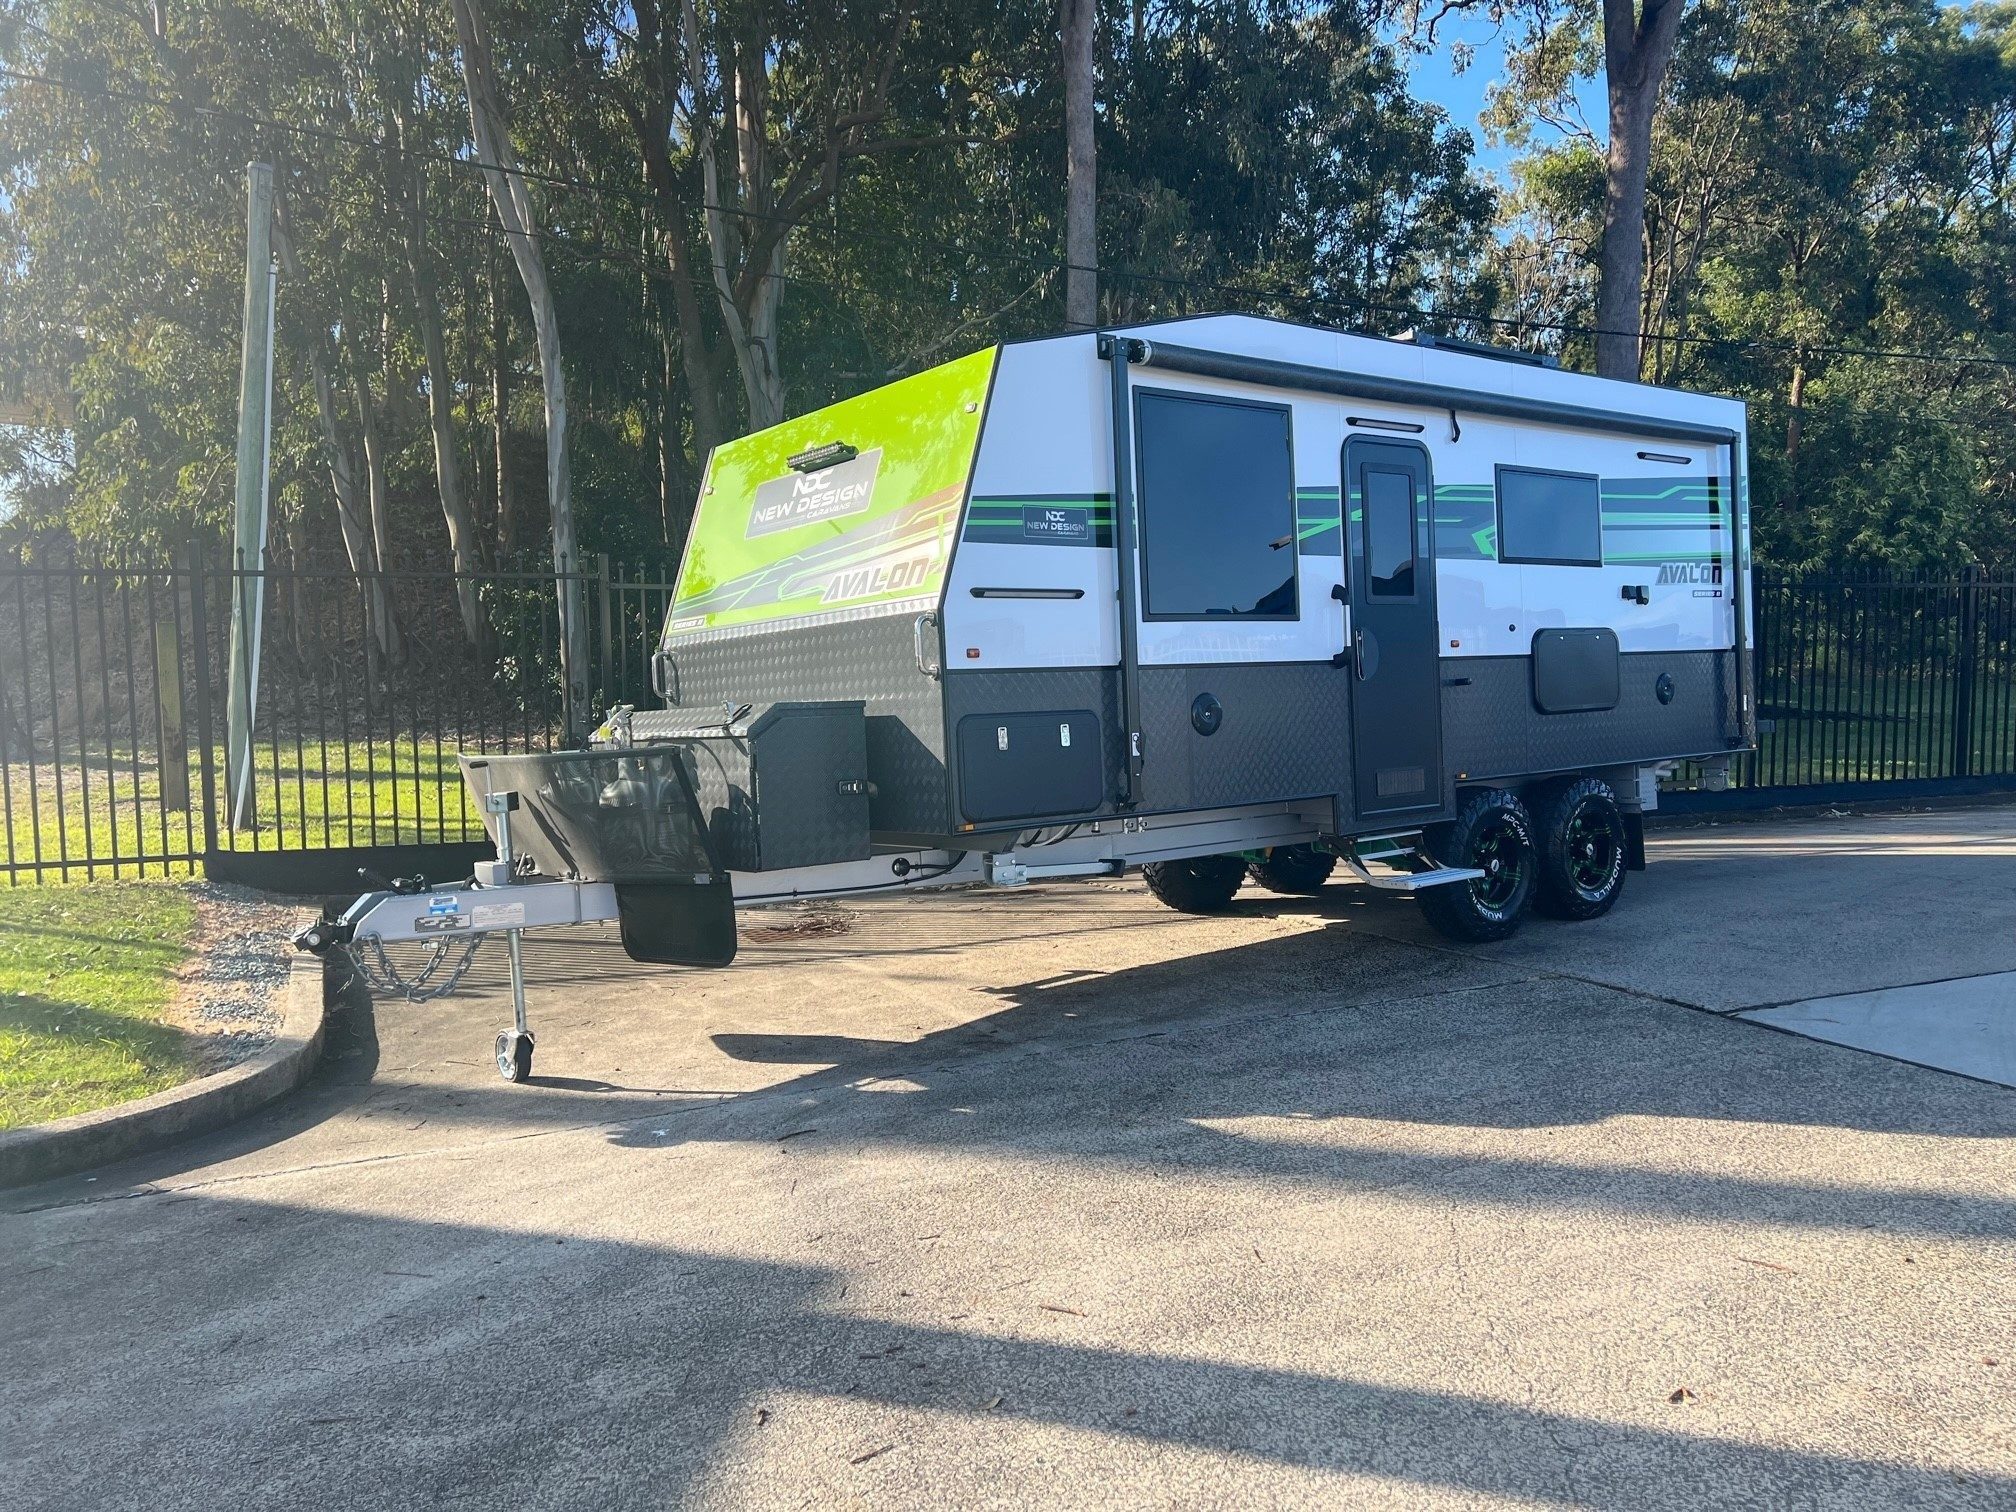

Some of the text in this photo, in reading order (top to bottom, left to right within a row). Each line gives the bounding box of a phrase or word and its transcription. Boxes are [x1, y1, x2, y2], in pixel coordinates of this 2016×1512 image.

[792, 468, 834, 498] NDC
[753, 481, 869, 524] NEW DESIGN
[806, 502, 852, 519] CARAVANS
[1027, 521, 1085, 532] NEW DESIGN
[1045, 510, 1066, 522] NDC
[821, 556, 931, 603] AVALON
[1656, 563, 1722, 585] AVALON
[1593, 846, 1622, 899] MUDZILLA
